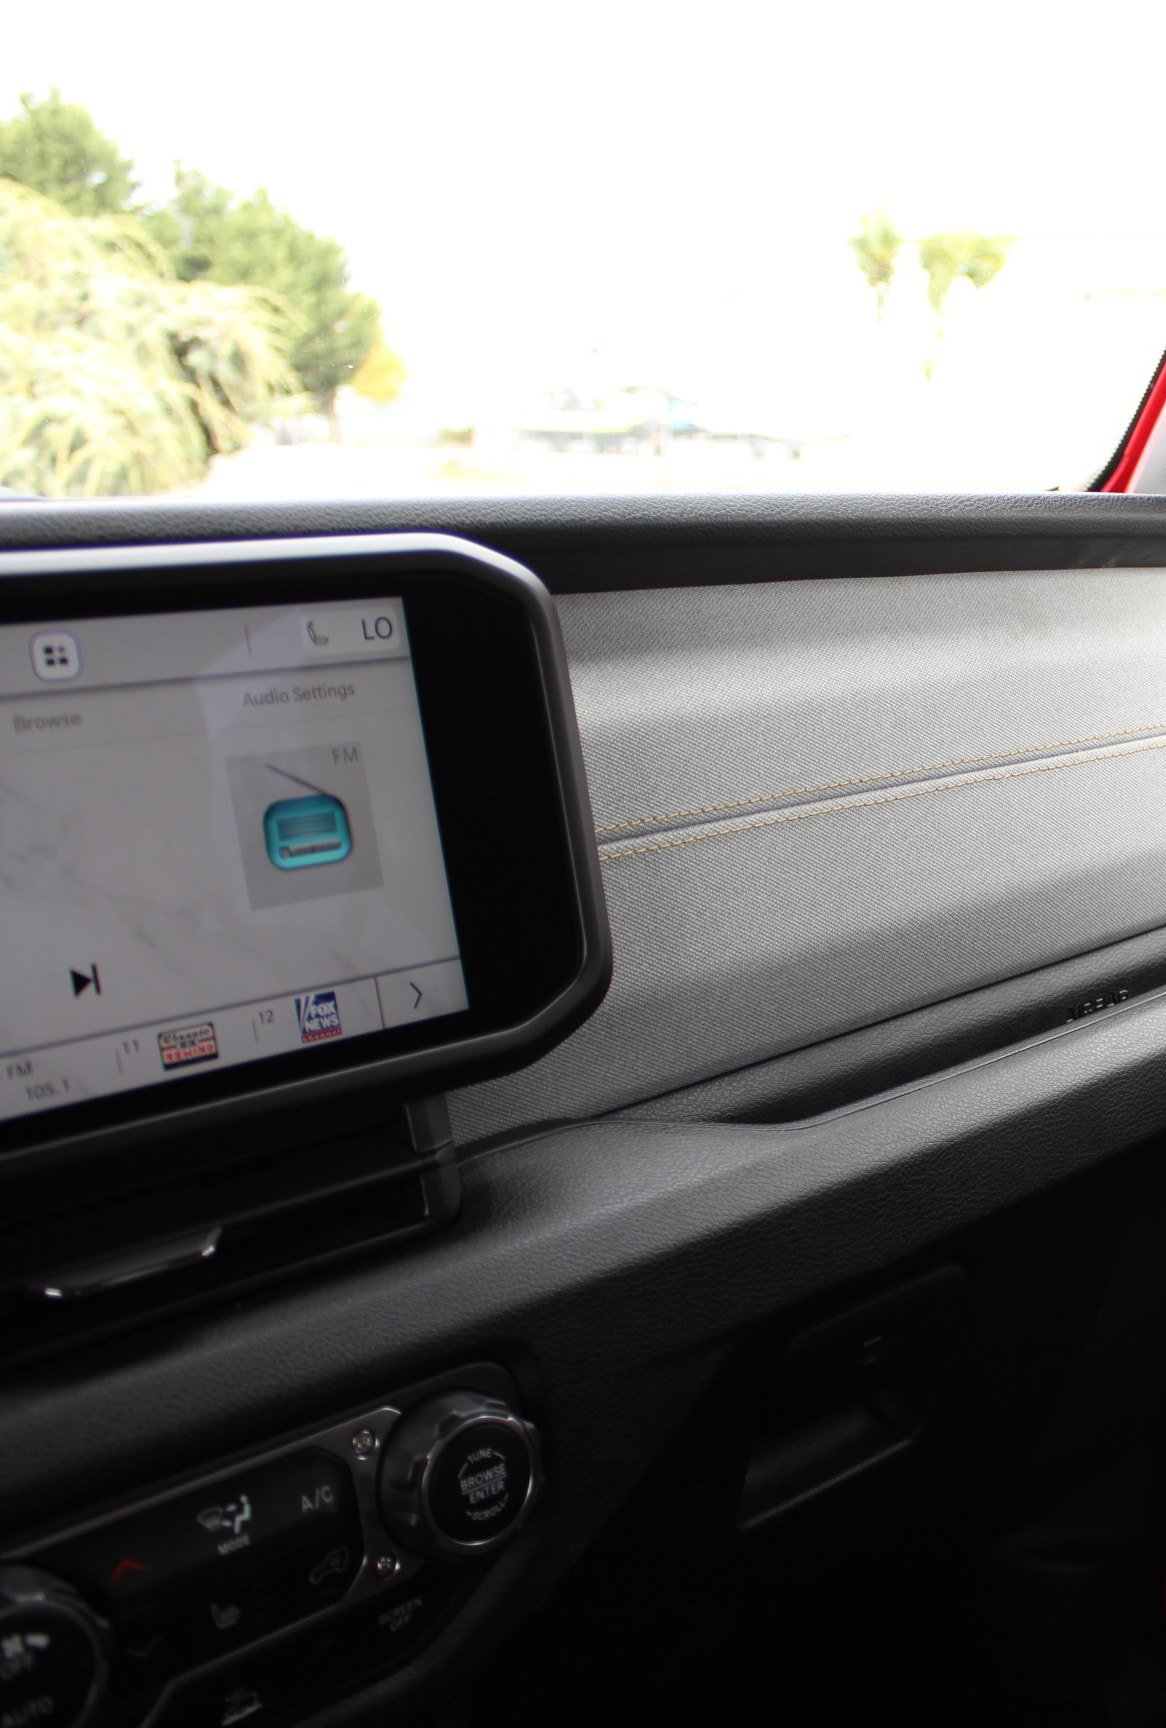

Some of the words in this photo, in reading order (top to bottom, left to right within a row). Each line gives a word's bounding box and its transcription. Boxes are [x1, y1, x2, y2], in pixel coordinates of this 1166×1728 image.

[361, 616, 393, 640] LO
[243, 688, 290, 707] Audio
[292, 684, 355, 703] Settings
[13, 712, 82, 734] Browse
[332, 747, 359, 764] FM
[310, 1001, 337, 1019] FOX
[304, 1014, 339, 1033] NEWS
[165, 1044, 214, 1063] REWIND
[26, 1077, 70, 1100] 105.1
[467, 1447, 493, 1464] TUNE
[460, 1463, 507, 1493] BROWSE
[301, 1486, 333, 1513] A/C
[469, 1480, 505, 1504] ENTER
[472, 1499, 507, 1521] SCROLL
[217, 1534, 250, 1556] MODE
